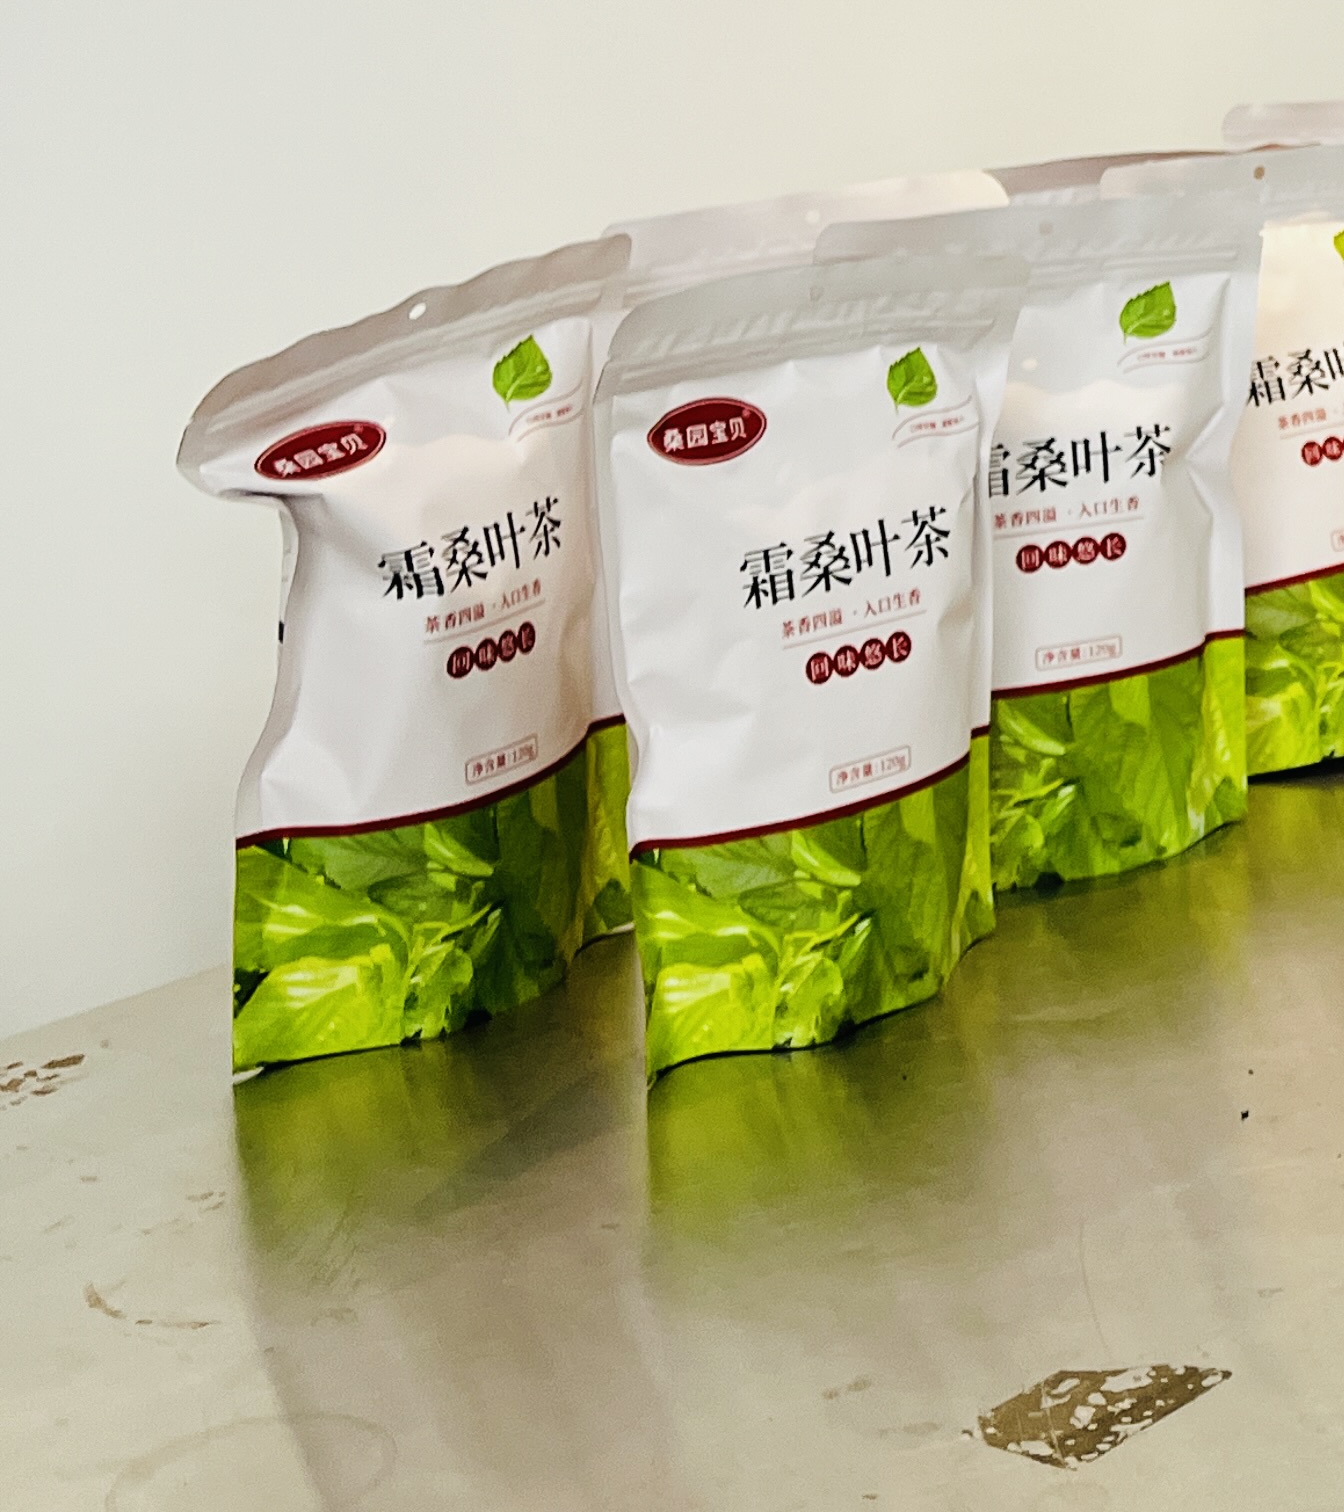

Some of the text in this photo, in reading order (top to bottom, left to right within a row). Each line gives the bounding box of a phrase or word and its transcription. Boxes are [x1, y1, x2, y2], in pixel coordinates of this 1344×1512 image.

[272, 431, 370, 479] 桑园宝贝
[663, 416, 748, 454] 桑园宝贝
[377, 496, 561, 600] 霜桑叶茶
[740, 506, 950, 610] 霜桑叶茶
[1020, 534, 1125, 570] 回味悠长
[810, 633, 909, 682] 回味悠长
